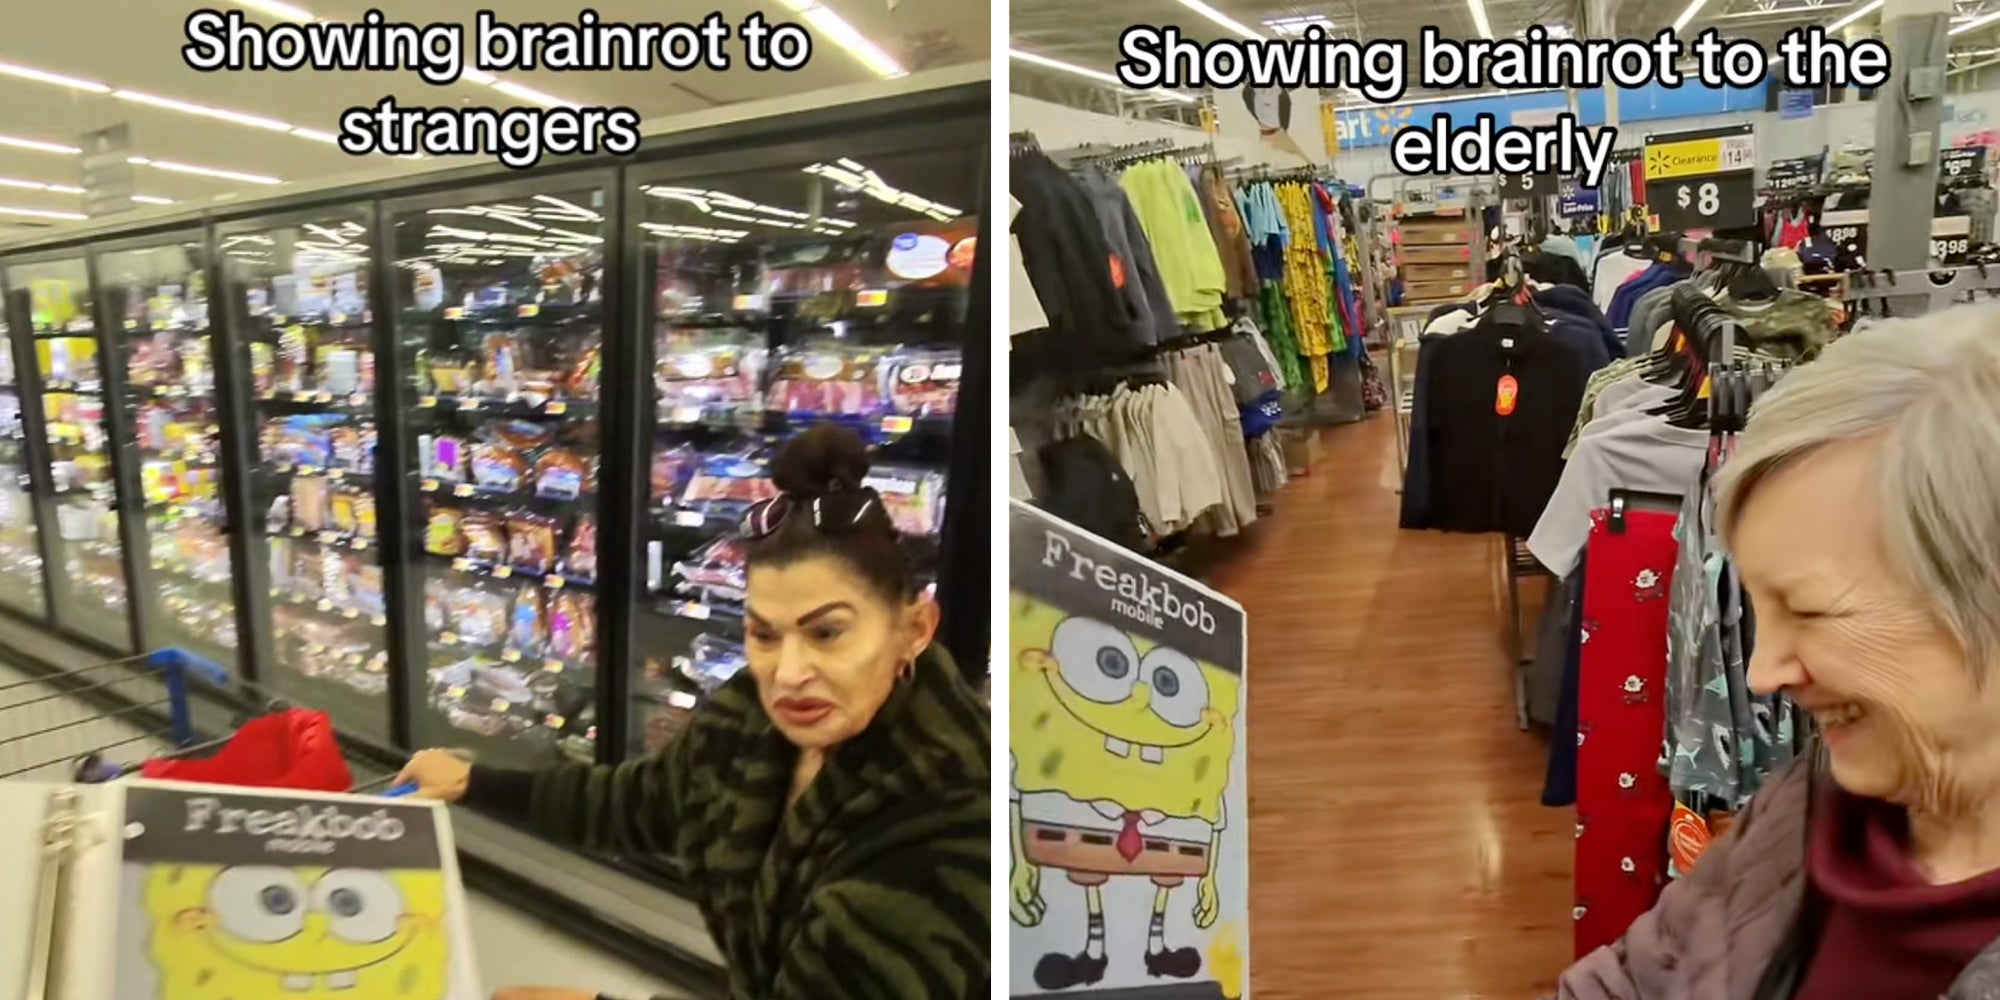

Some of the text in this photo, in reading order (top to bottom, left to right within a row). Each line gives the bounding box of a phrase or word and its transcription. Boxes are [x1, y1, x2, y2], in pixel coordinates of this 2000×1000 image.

[1672, 154, 1718, 166] Clearance
[1042, 530, 1216, 635] Freakbob
[1111, 598, 1164, 630] mobile
[184, 797, 405, 841] Freakbob
